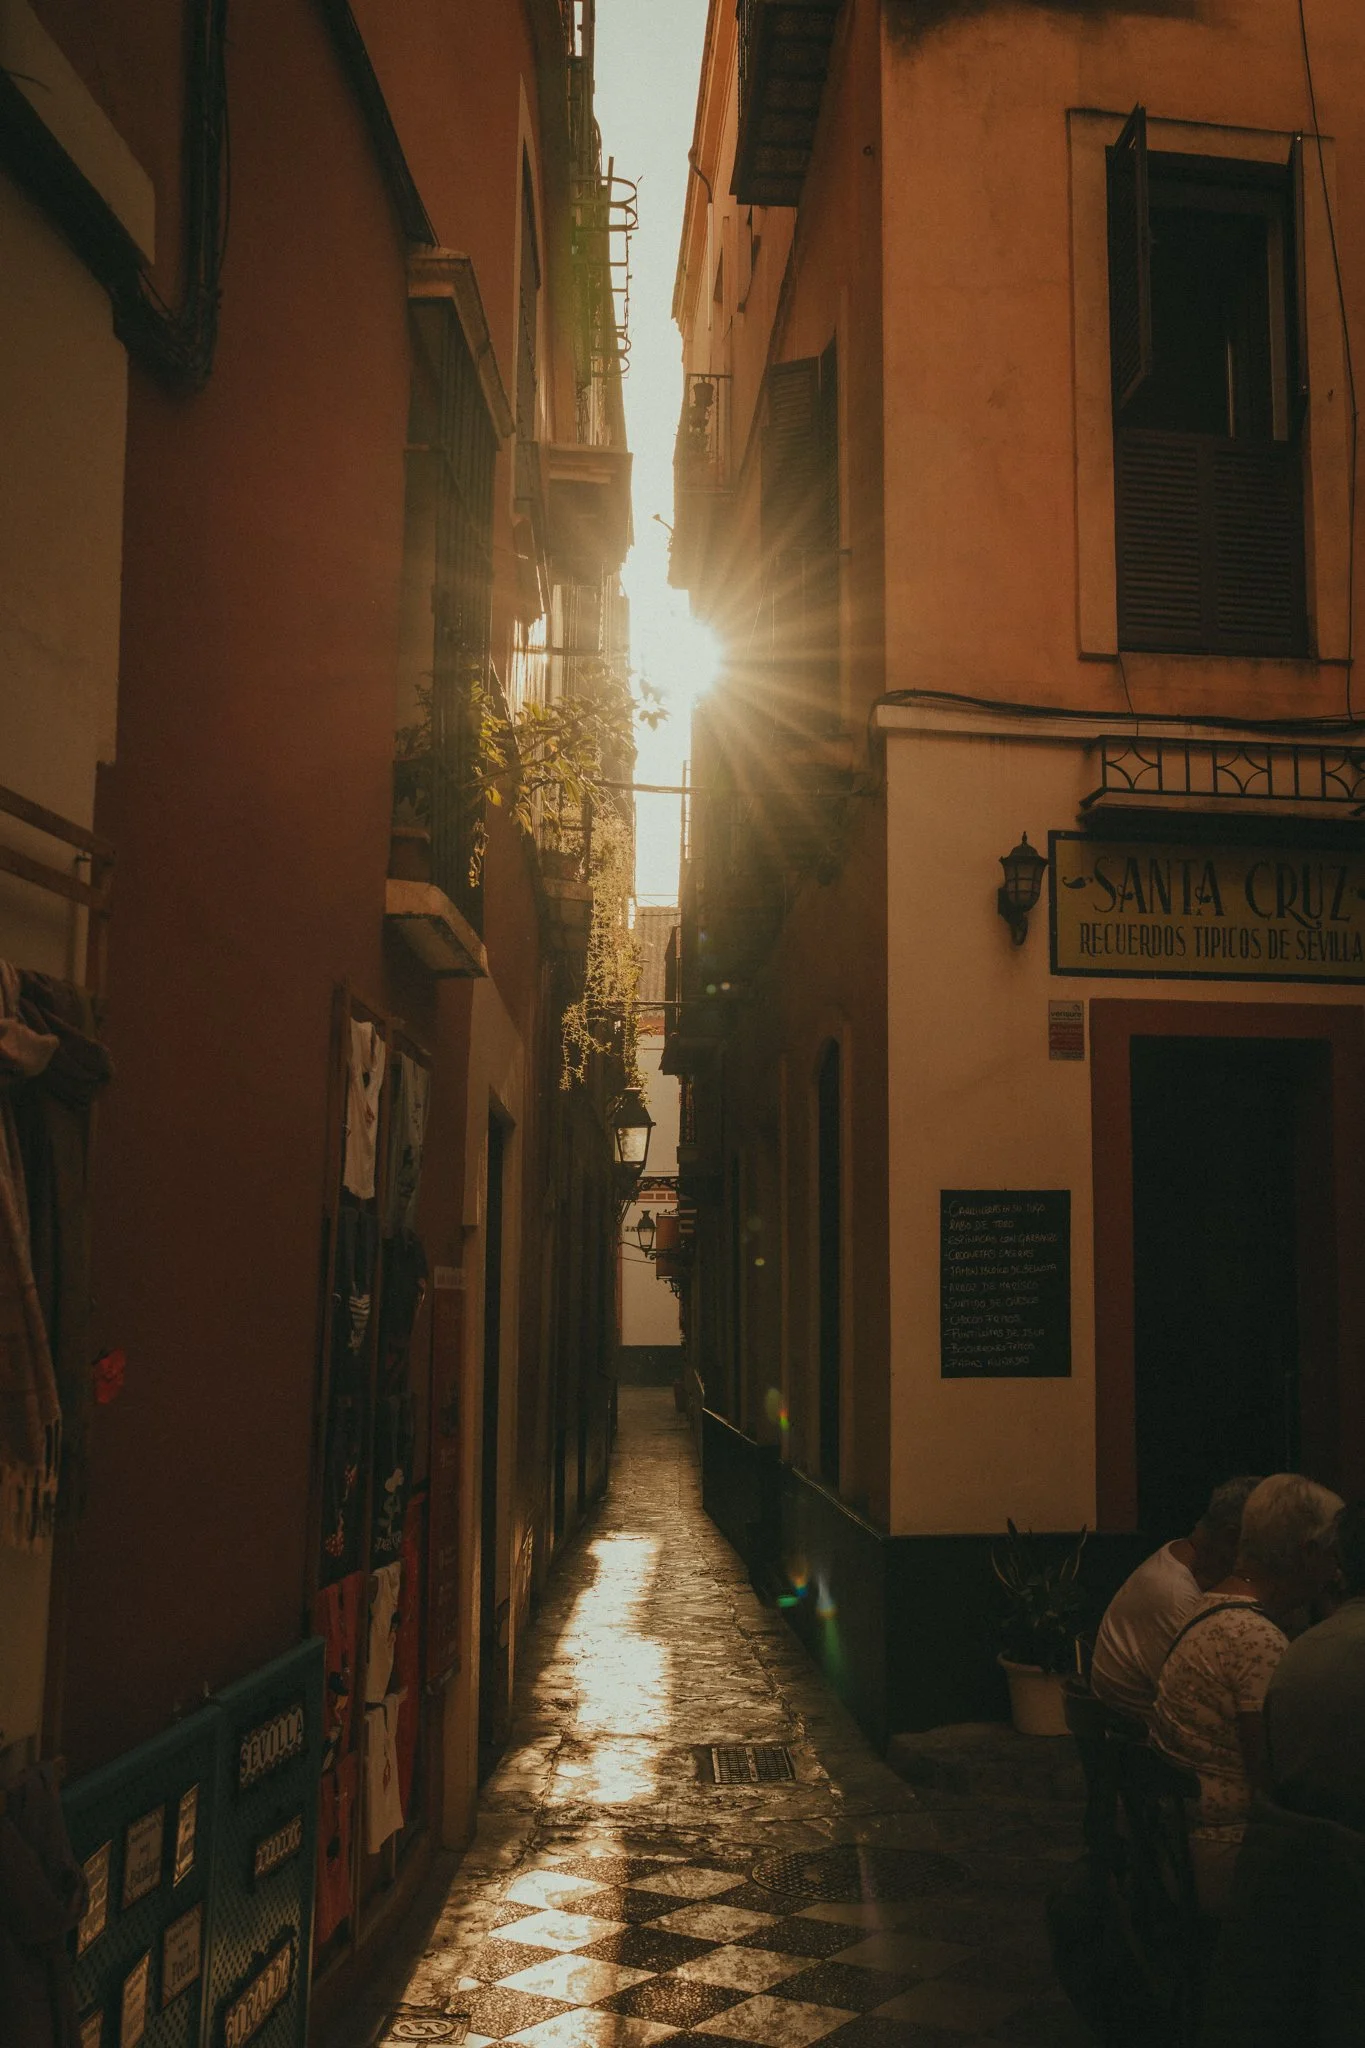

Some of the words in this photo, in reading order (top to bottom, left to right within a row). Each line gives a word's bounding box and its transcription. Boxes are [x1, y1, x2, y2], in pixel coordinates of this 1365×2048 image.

[1093, 856, 1225, 917] SANTA
[1245, 858, 1351, 930] CRUZ
[1079, 922, 1186, 958] RECUERDOS
[1193, 925, 1261, 960] TIPICOS
[1268, 929, 1290, 960] DE
[1296, 929, 1364, 962] SEVILLA
